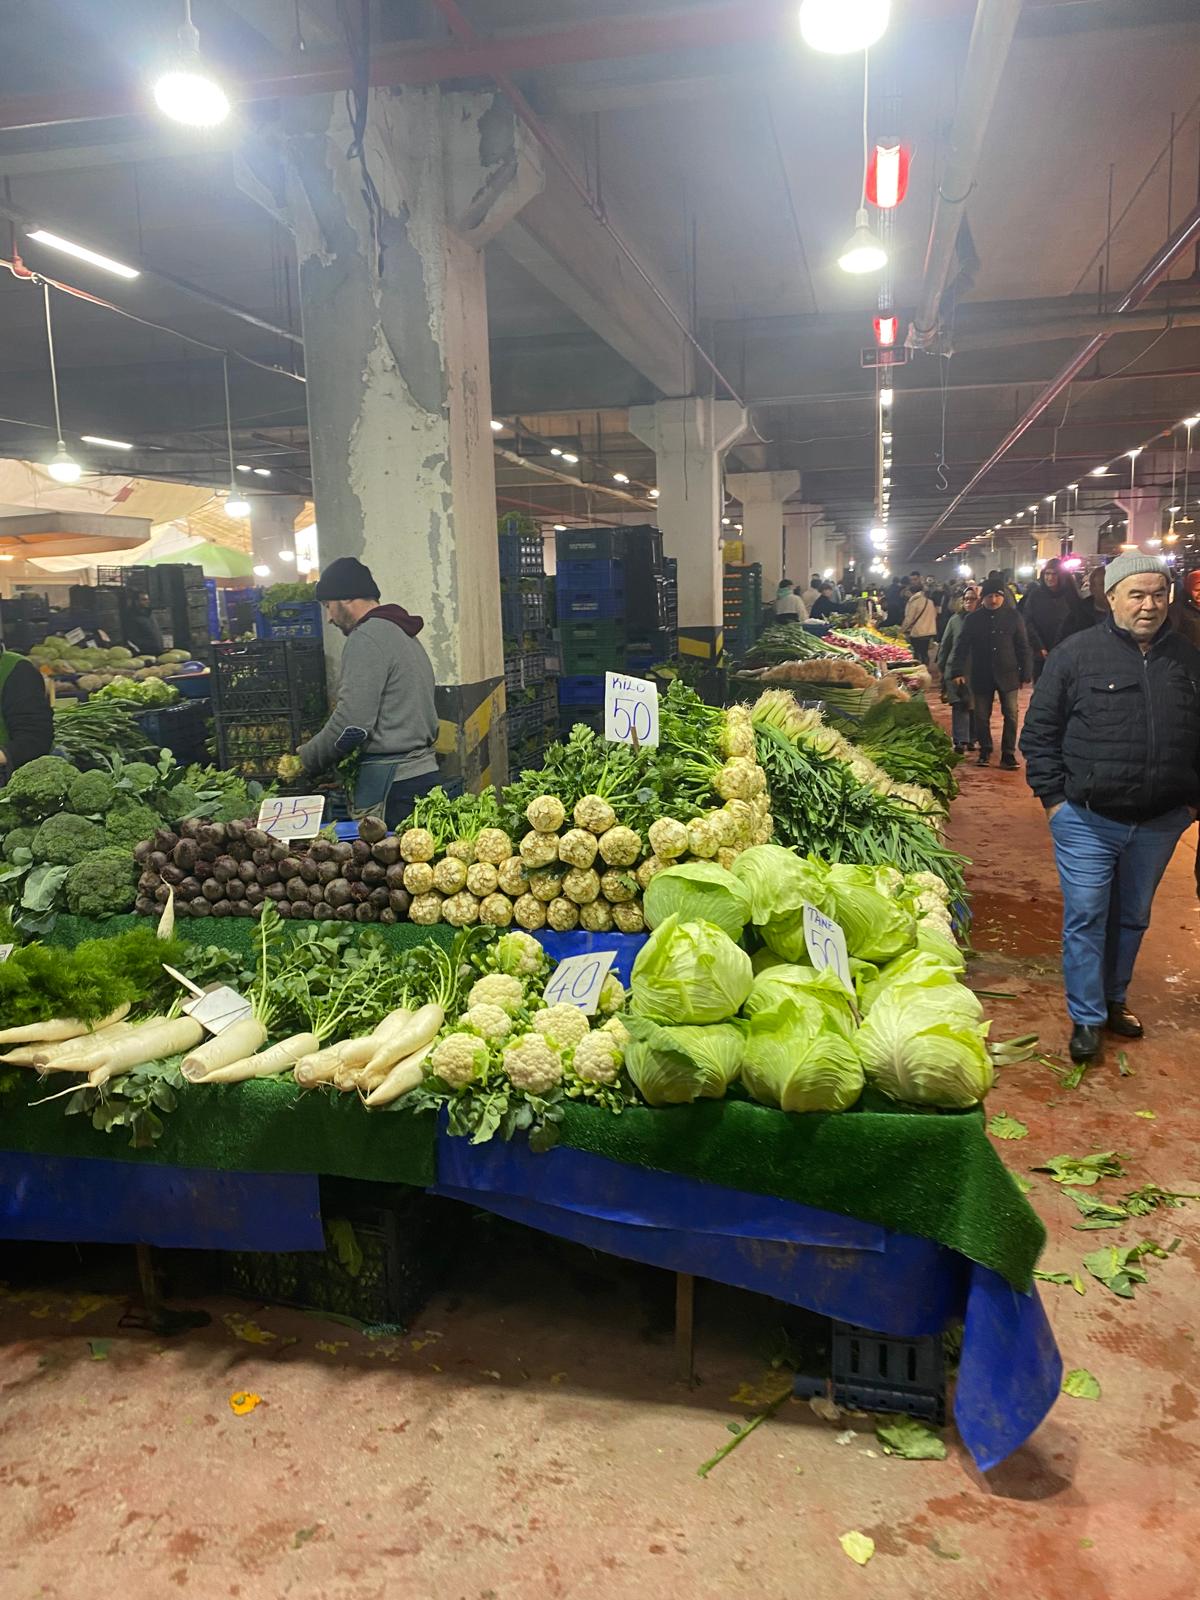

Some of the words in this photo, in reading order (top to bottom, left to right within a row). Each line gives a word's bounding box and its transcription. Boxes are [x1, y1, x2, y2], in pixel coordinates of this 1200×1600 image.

[613, 698, 651, 741] 50
[265, 797, 309, 832] 25
[808, 907, 835, 933] TANE
[811, 929, 845, 986] 50
[547, 961, 600, 1002] 40
